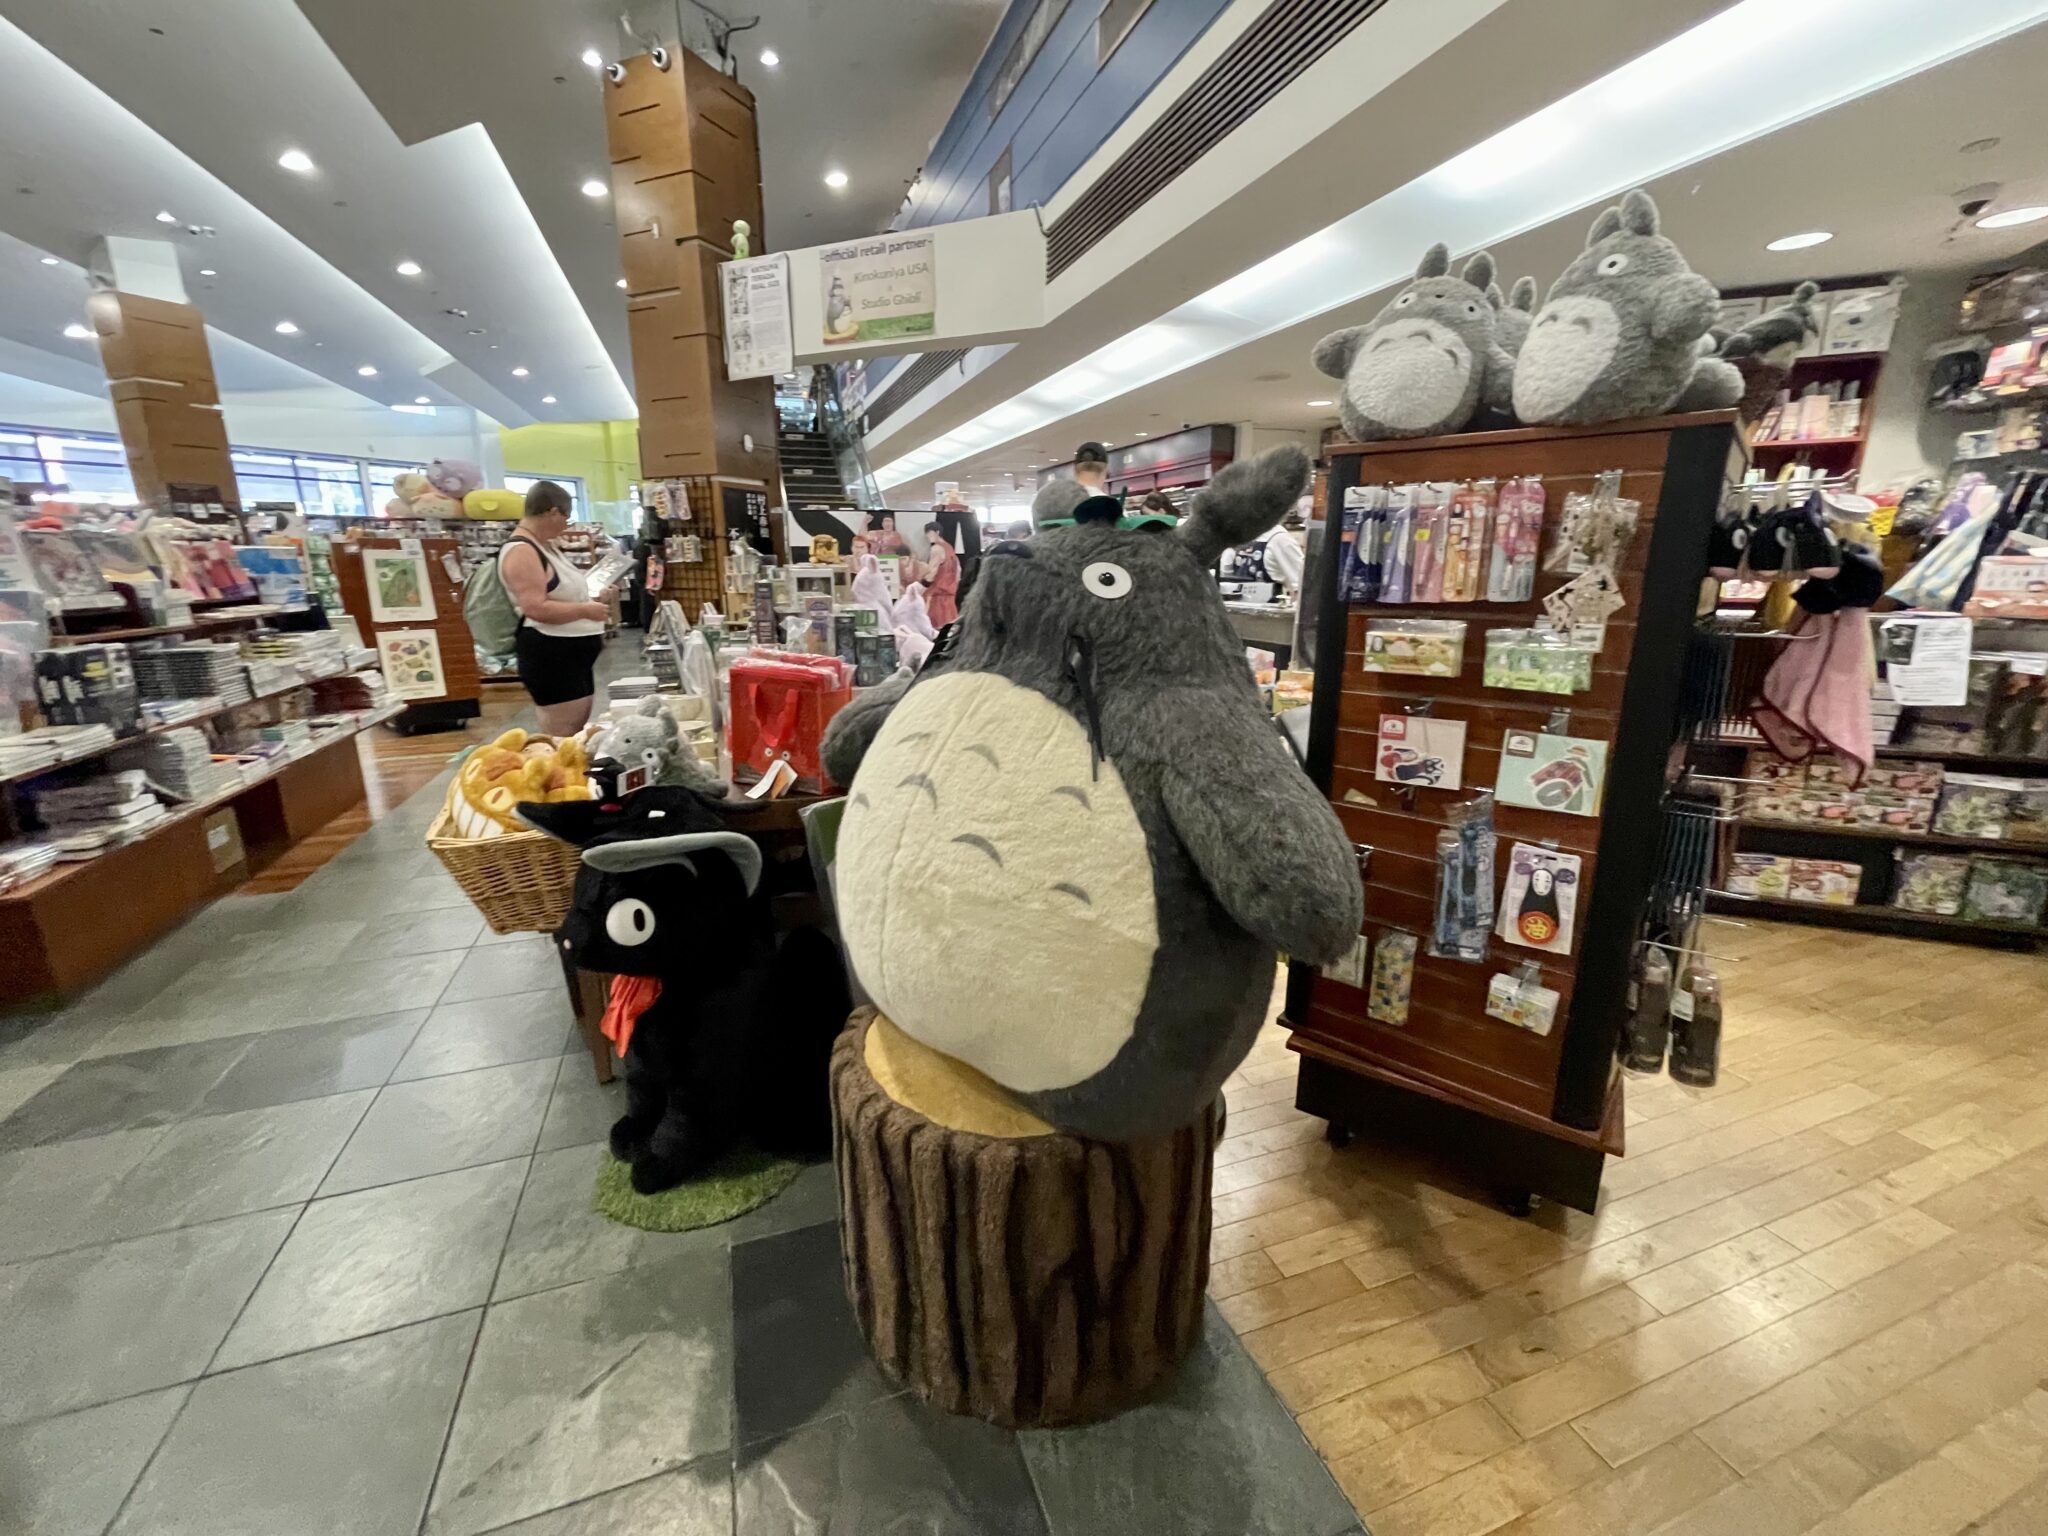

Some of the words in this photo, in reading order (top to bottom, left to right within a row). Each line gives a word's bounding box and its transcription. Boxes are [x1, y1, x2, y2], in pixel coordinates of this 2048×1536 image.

[860, 242, 886, 257] retail
[907, 262, 929, 275] USA
[861, 296, 891, 309] Studio
[893, 291, 922, 305] Ghibli
